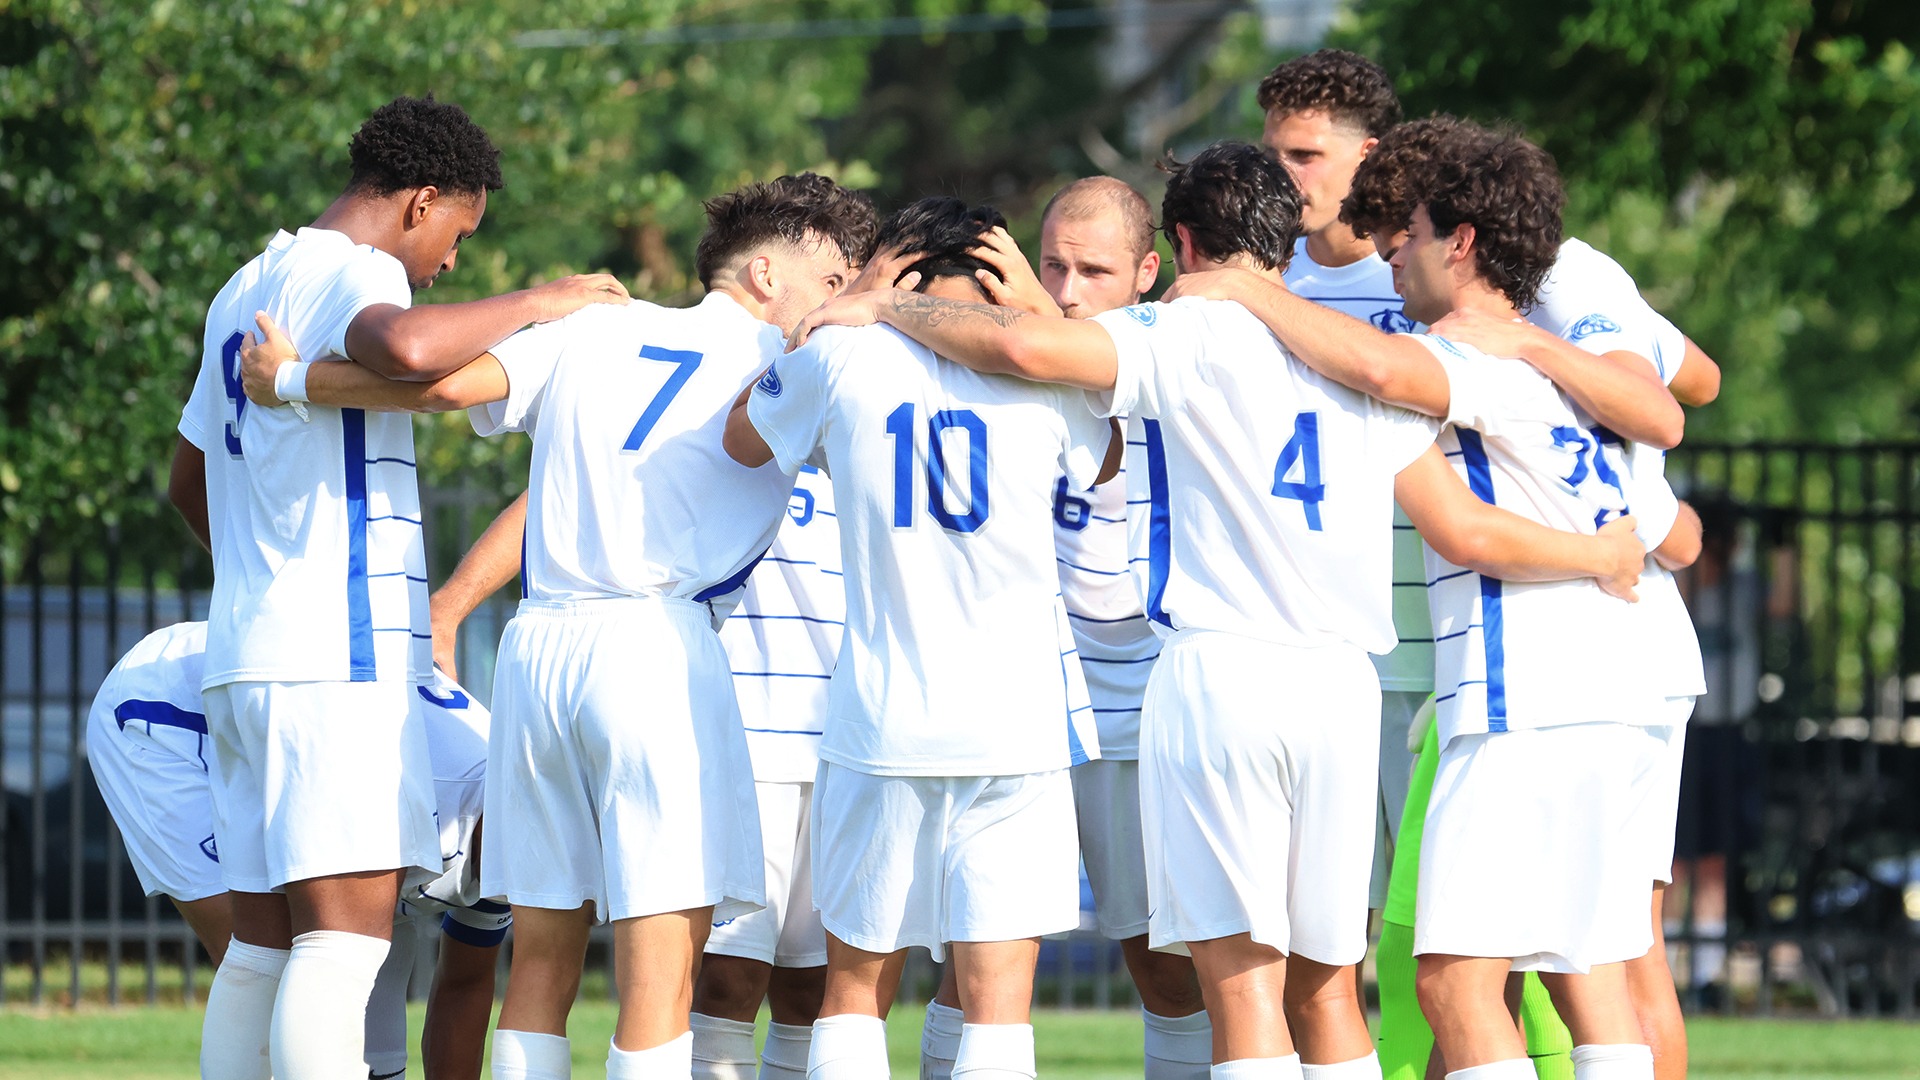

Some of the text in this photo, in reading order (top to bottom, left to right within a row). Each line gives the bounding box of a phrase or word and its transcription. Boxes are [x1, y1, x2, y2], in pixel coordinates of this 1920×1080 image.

[621, 343, 705, 452] 7
[885, 400, 991, 534] 10
[1053, 474, 1096, 532] 6
[1270, 411, 1326, 532] 4
